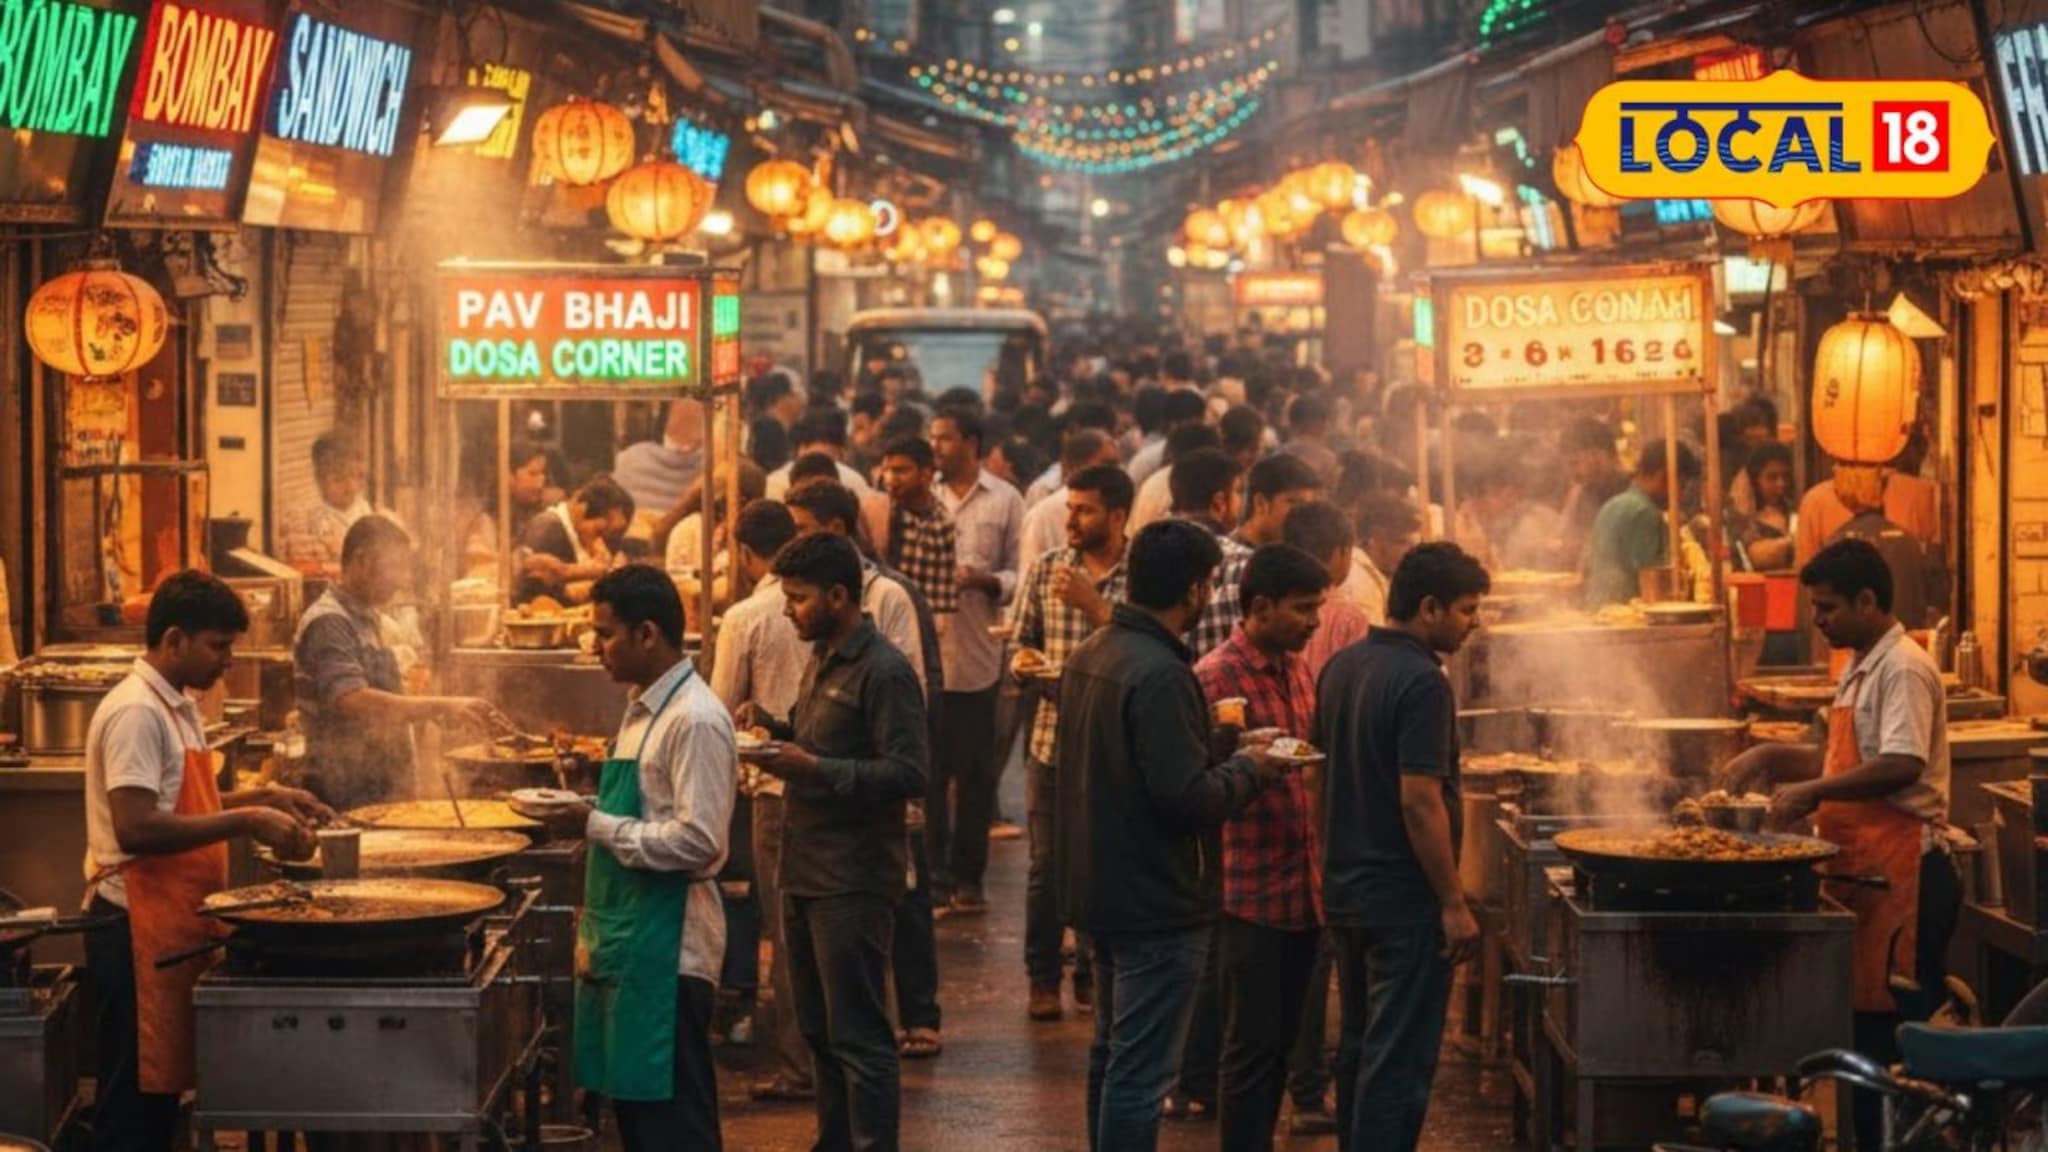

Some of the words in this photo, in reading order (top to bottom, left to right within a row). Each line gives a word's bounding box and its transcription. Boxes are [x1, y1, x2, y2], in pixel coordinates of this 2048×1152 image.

[143, 4, 275, 133] BOMBAY
[458, 291, 543, 328] PAV
[564, 291, 690, 329] BHAJI
[1466, 294, 1558, 329] DOSA
[451, 338, 540, 377] DOSA
[552, 338, 688, 377] CORNER
